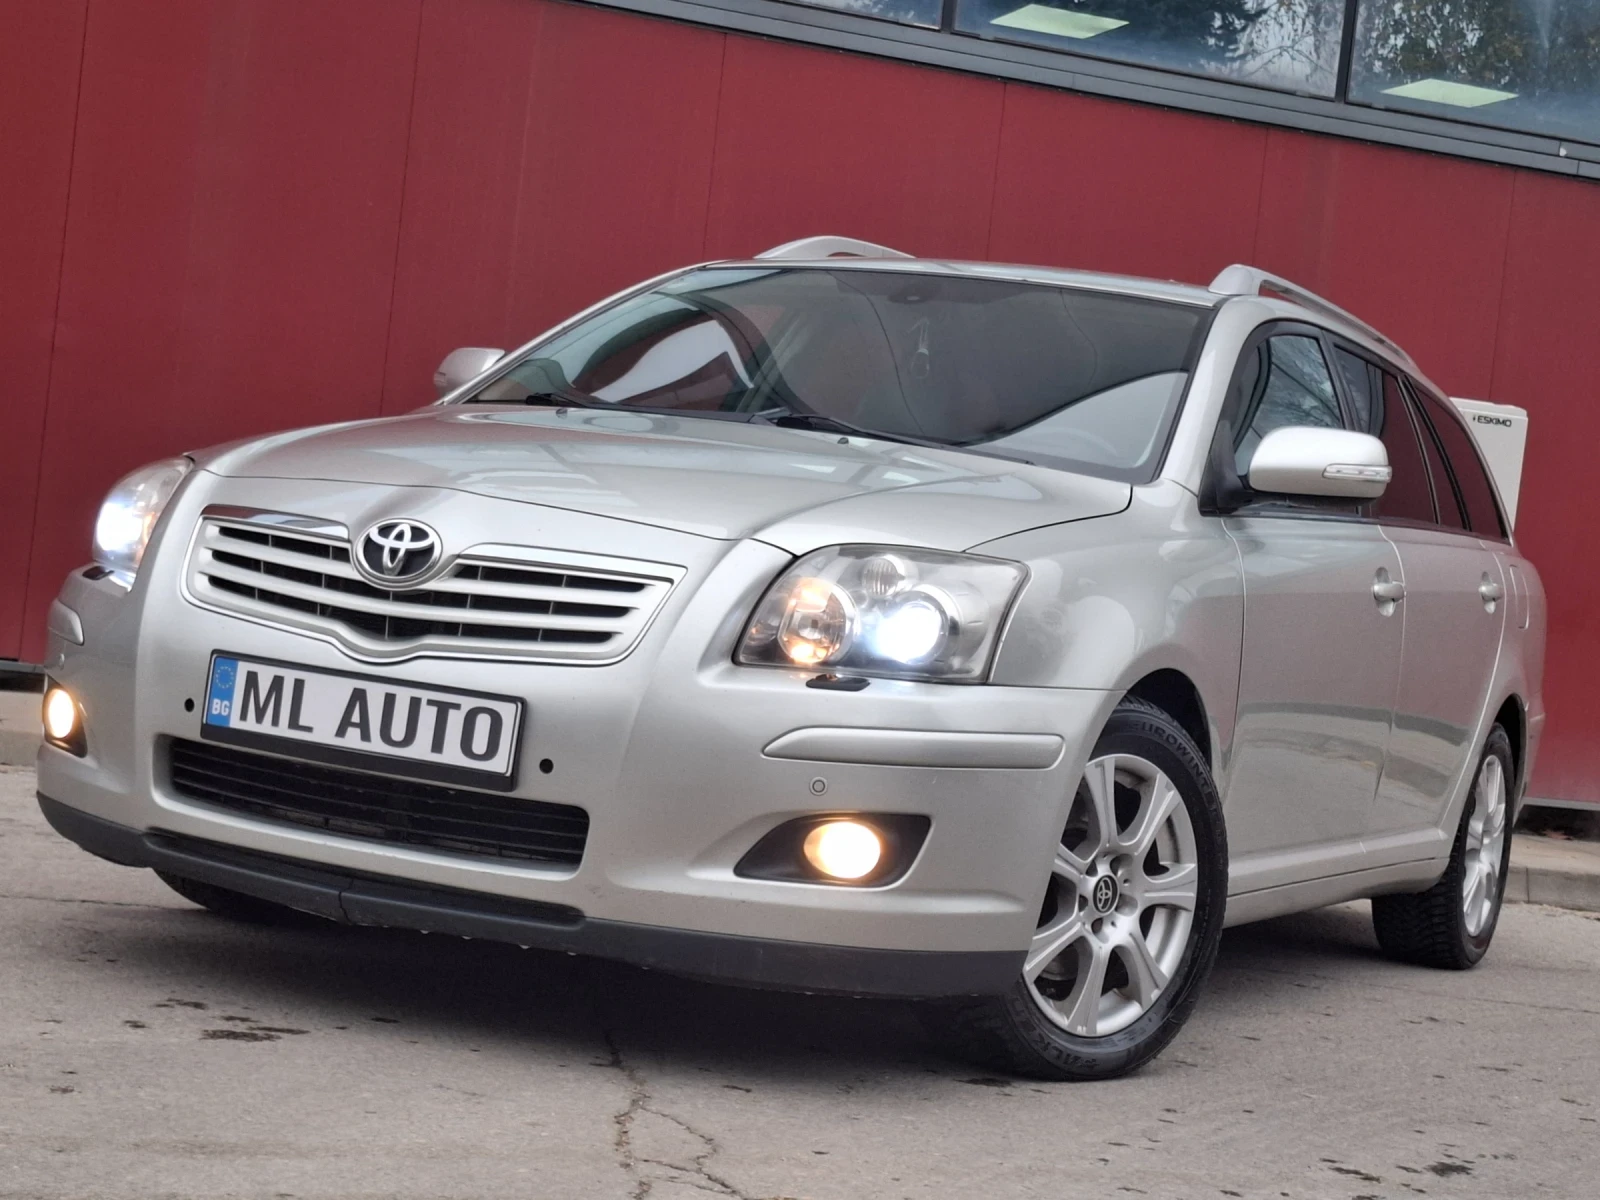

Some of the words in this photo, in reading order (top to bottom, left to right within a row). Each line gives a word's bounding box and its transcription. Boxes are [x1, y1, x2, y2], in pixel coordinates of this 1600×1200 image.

[1477, 415, 1512, 428] ESKIMO
[212, 698, 230, 717] BG
[239, 670, 314, 733] ML
[335, 687, 503, 762] AUTO
